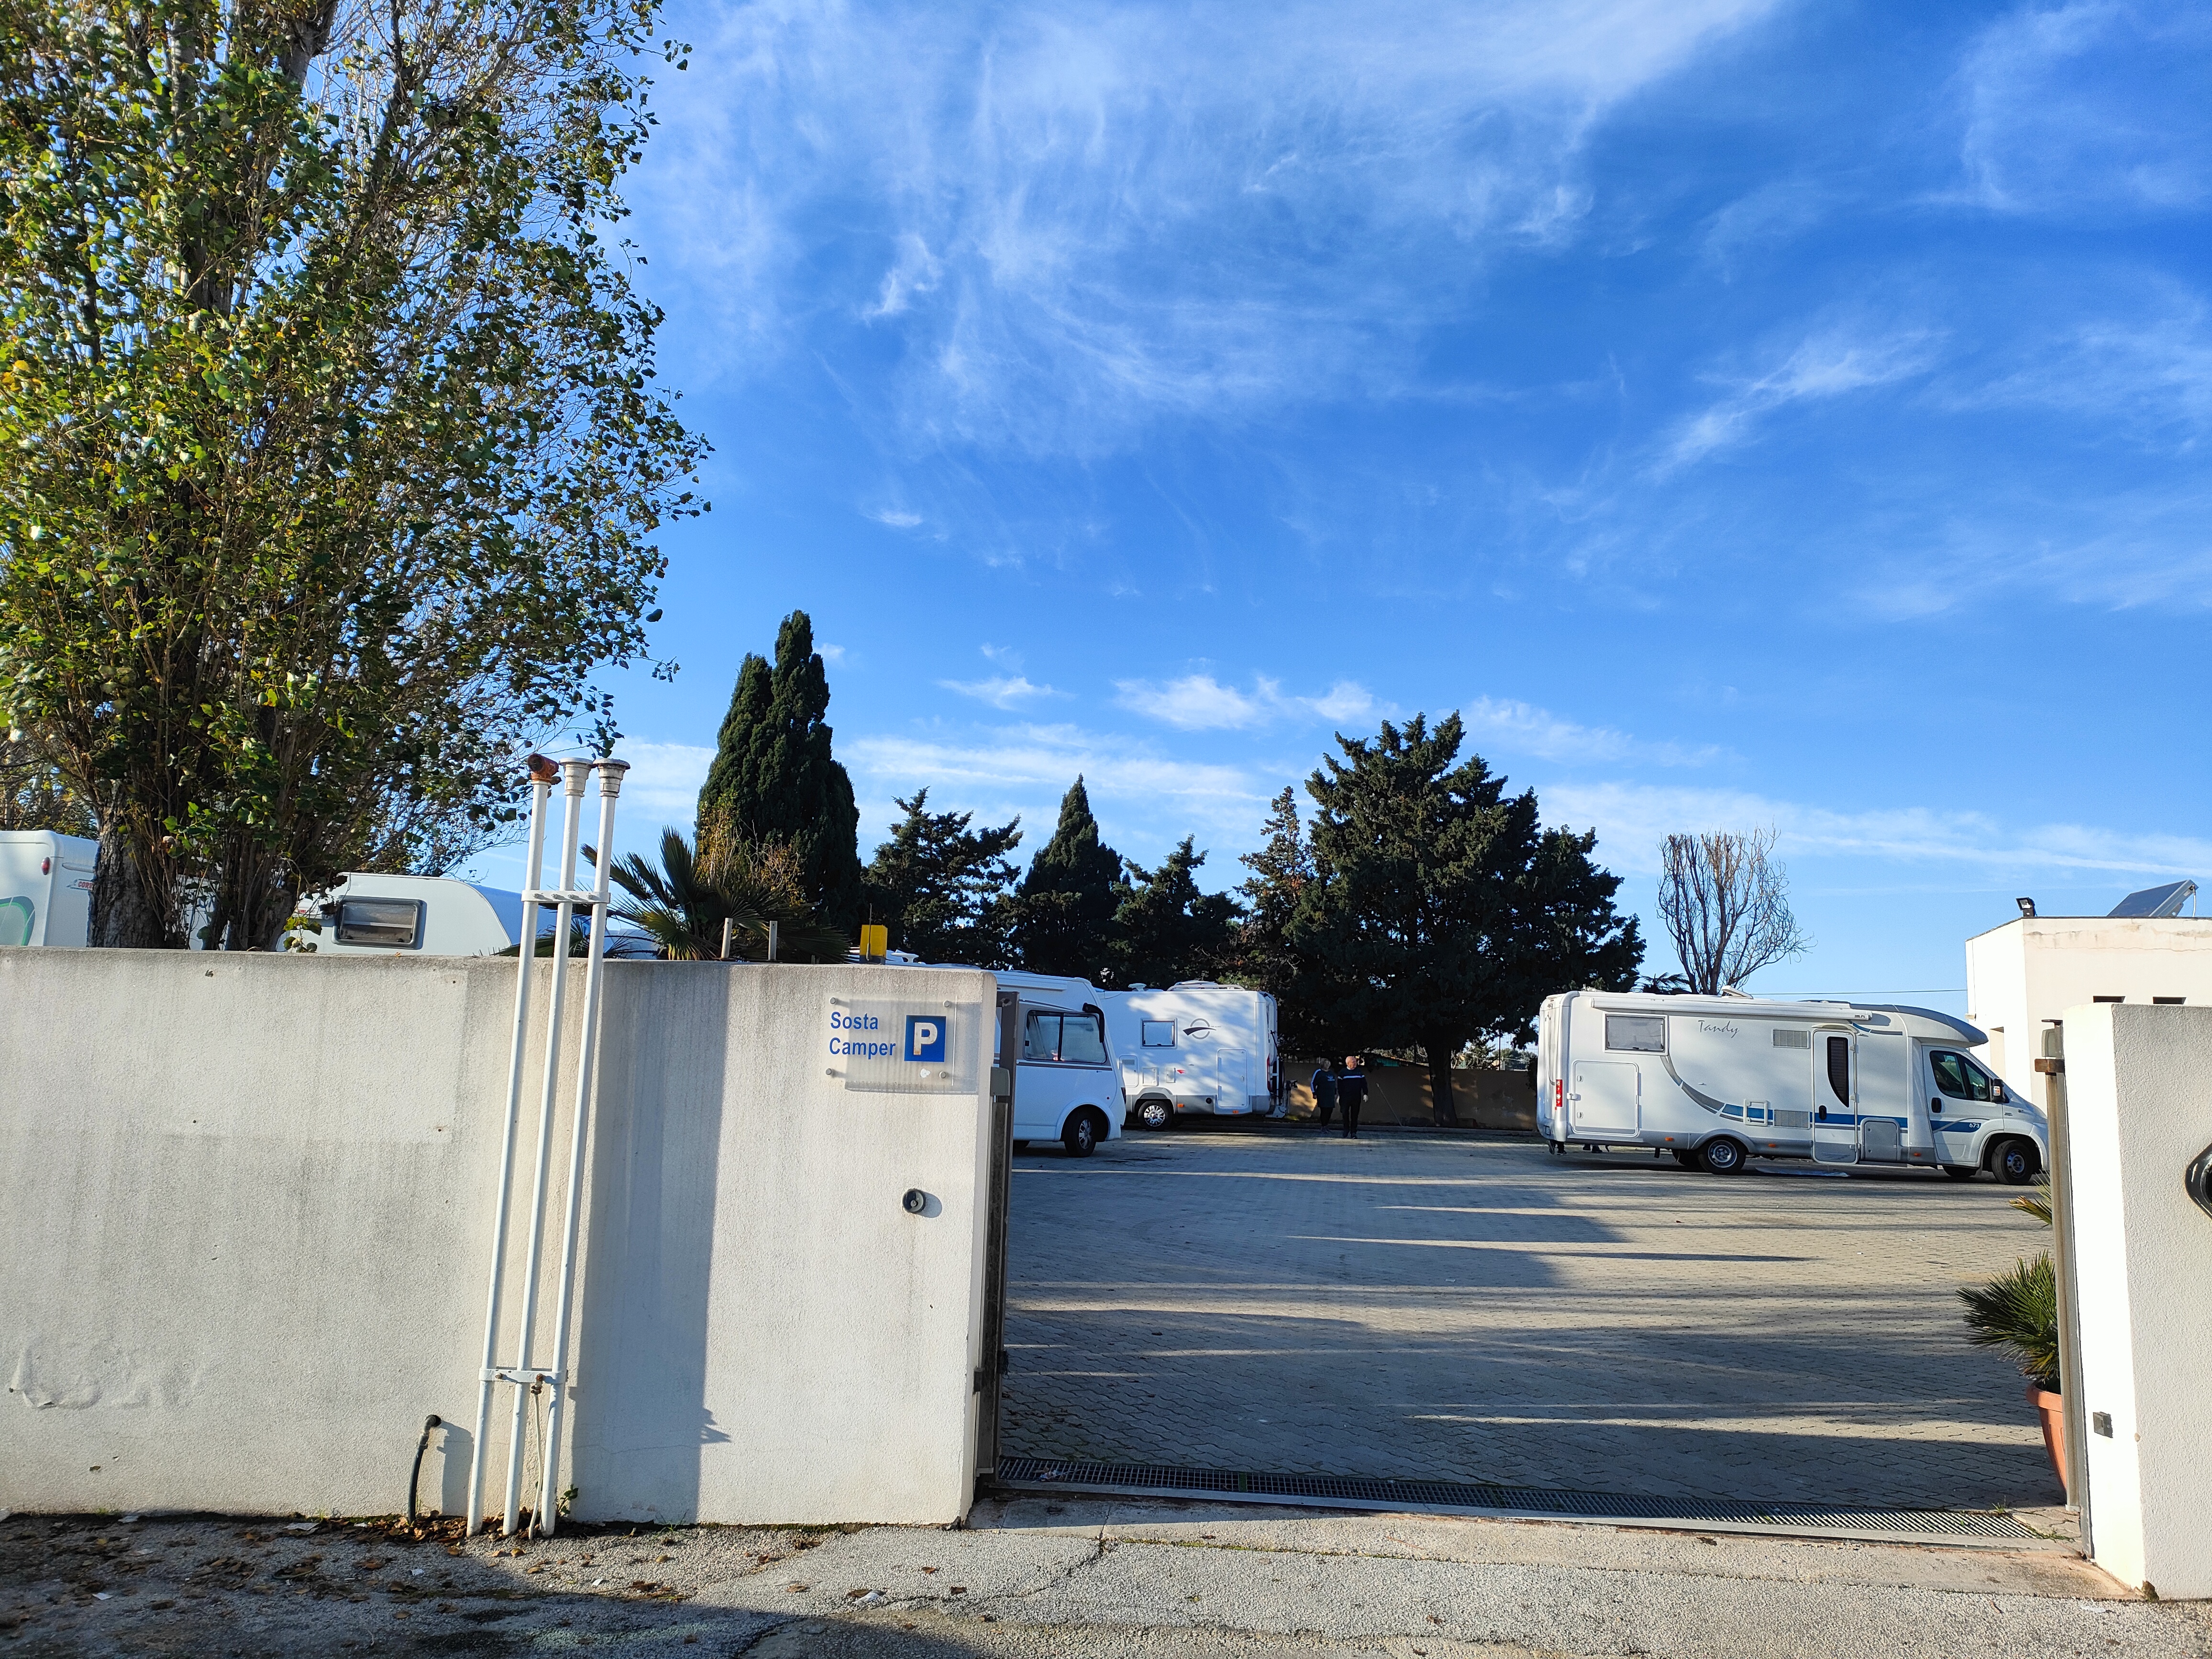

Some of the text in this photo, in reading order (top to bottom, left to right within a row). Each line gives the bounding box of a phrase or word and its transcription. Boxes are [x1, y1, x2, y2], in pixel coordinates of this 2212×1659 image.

[830, 1012, 878, 1029] Sosta
[1698, 1020, 1739, 1038] Tandy
[830, 1037, 896, 1060] Camper
[913, 1022, 938, 1055] P
